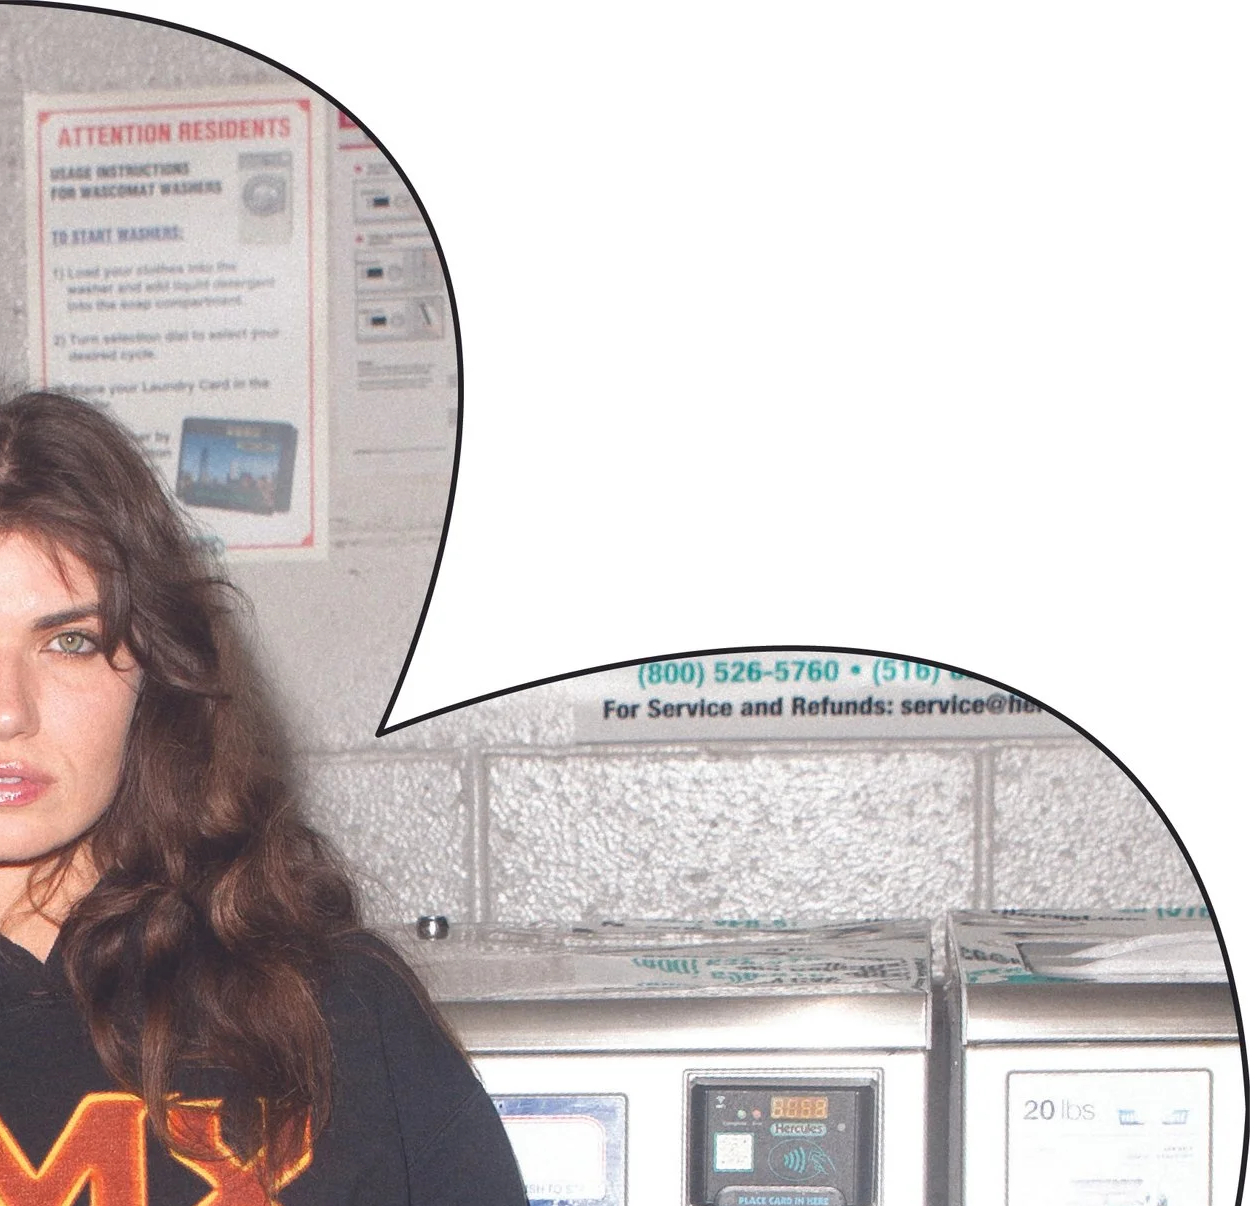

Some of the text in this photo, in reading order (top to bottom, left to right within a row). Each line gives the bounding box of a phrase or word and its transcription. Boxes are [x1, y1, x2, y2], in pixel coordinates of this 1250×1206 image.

[57, 117, 292, 148] ATTENTION RESIDENTS
[96, 161, 190, 179] INSTRUCTIONS
[50, 179, 223, 200] FOR WASCOMAT WASHERS
[51, 229, 68, 246] TO
[71, 227, 112, 245] START
[67, 266, 100, 279] Load
[103, 266, 133, 280] your
[136, 263, 185, 277] clothes
[187, 262, 214, 275] into
[216, 261, 237, 272] the
[67, 283, 113, 295] washer
[117, 282, 142, 294] and
[145, 279, 170, 292] add
[212, 276, 275, 291] detergent
[96, 299, 117, 310] the
[120, 299, 151, 312] soap
[53, 327, 280, 347] 2) Turn selection dial to select your
[69, 350, 117, 363] desired
[109, 384, 138, 396] your
[141, 380, 195, 396] Laundry
[199, 378, 230, 390] Card
[232, 379, 246, 390] in
[249, 377, 270, 390] the
[638, 661, 705, 689] (800)
[714, 658, 840, 683] 526-5760
[603, 700, 640, 720] For
[647, 698, 733, 719] Service
[740, 697, 784, 717] and
[791, 695, 893, 717] Refunds:
[1023, 1098, 1096, 1121] 20 lbs
[775, 1123, 824, 1133] Hercules
[738, 1196, 830, 1206] PLACE CARD IN HERE
